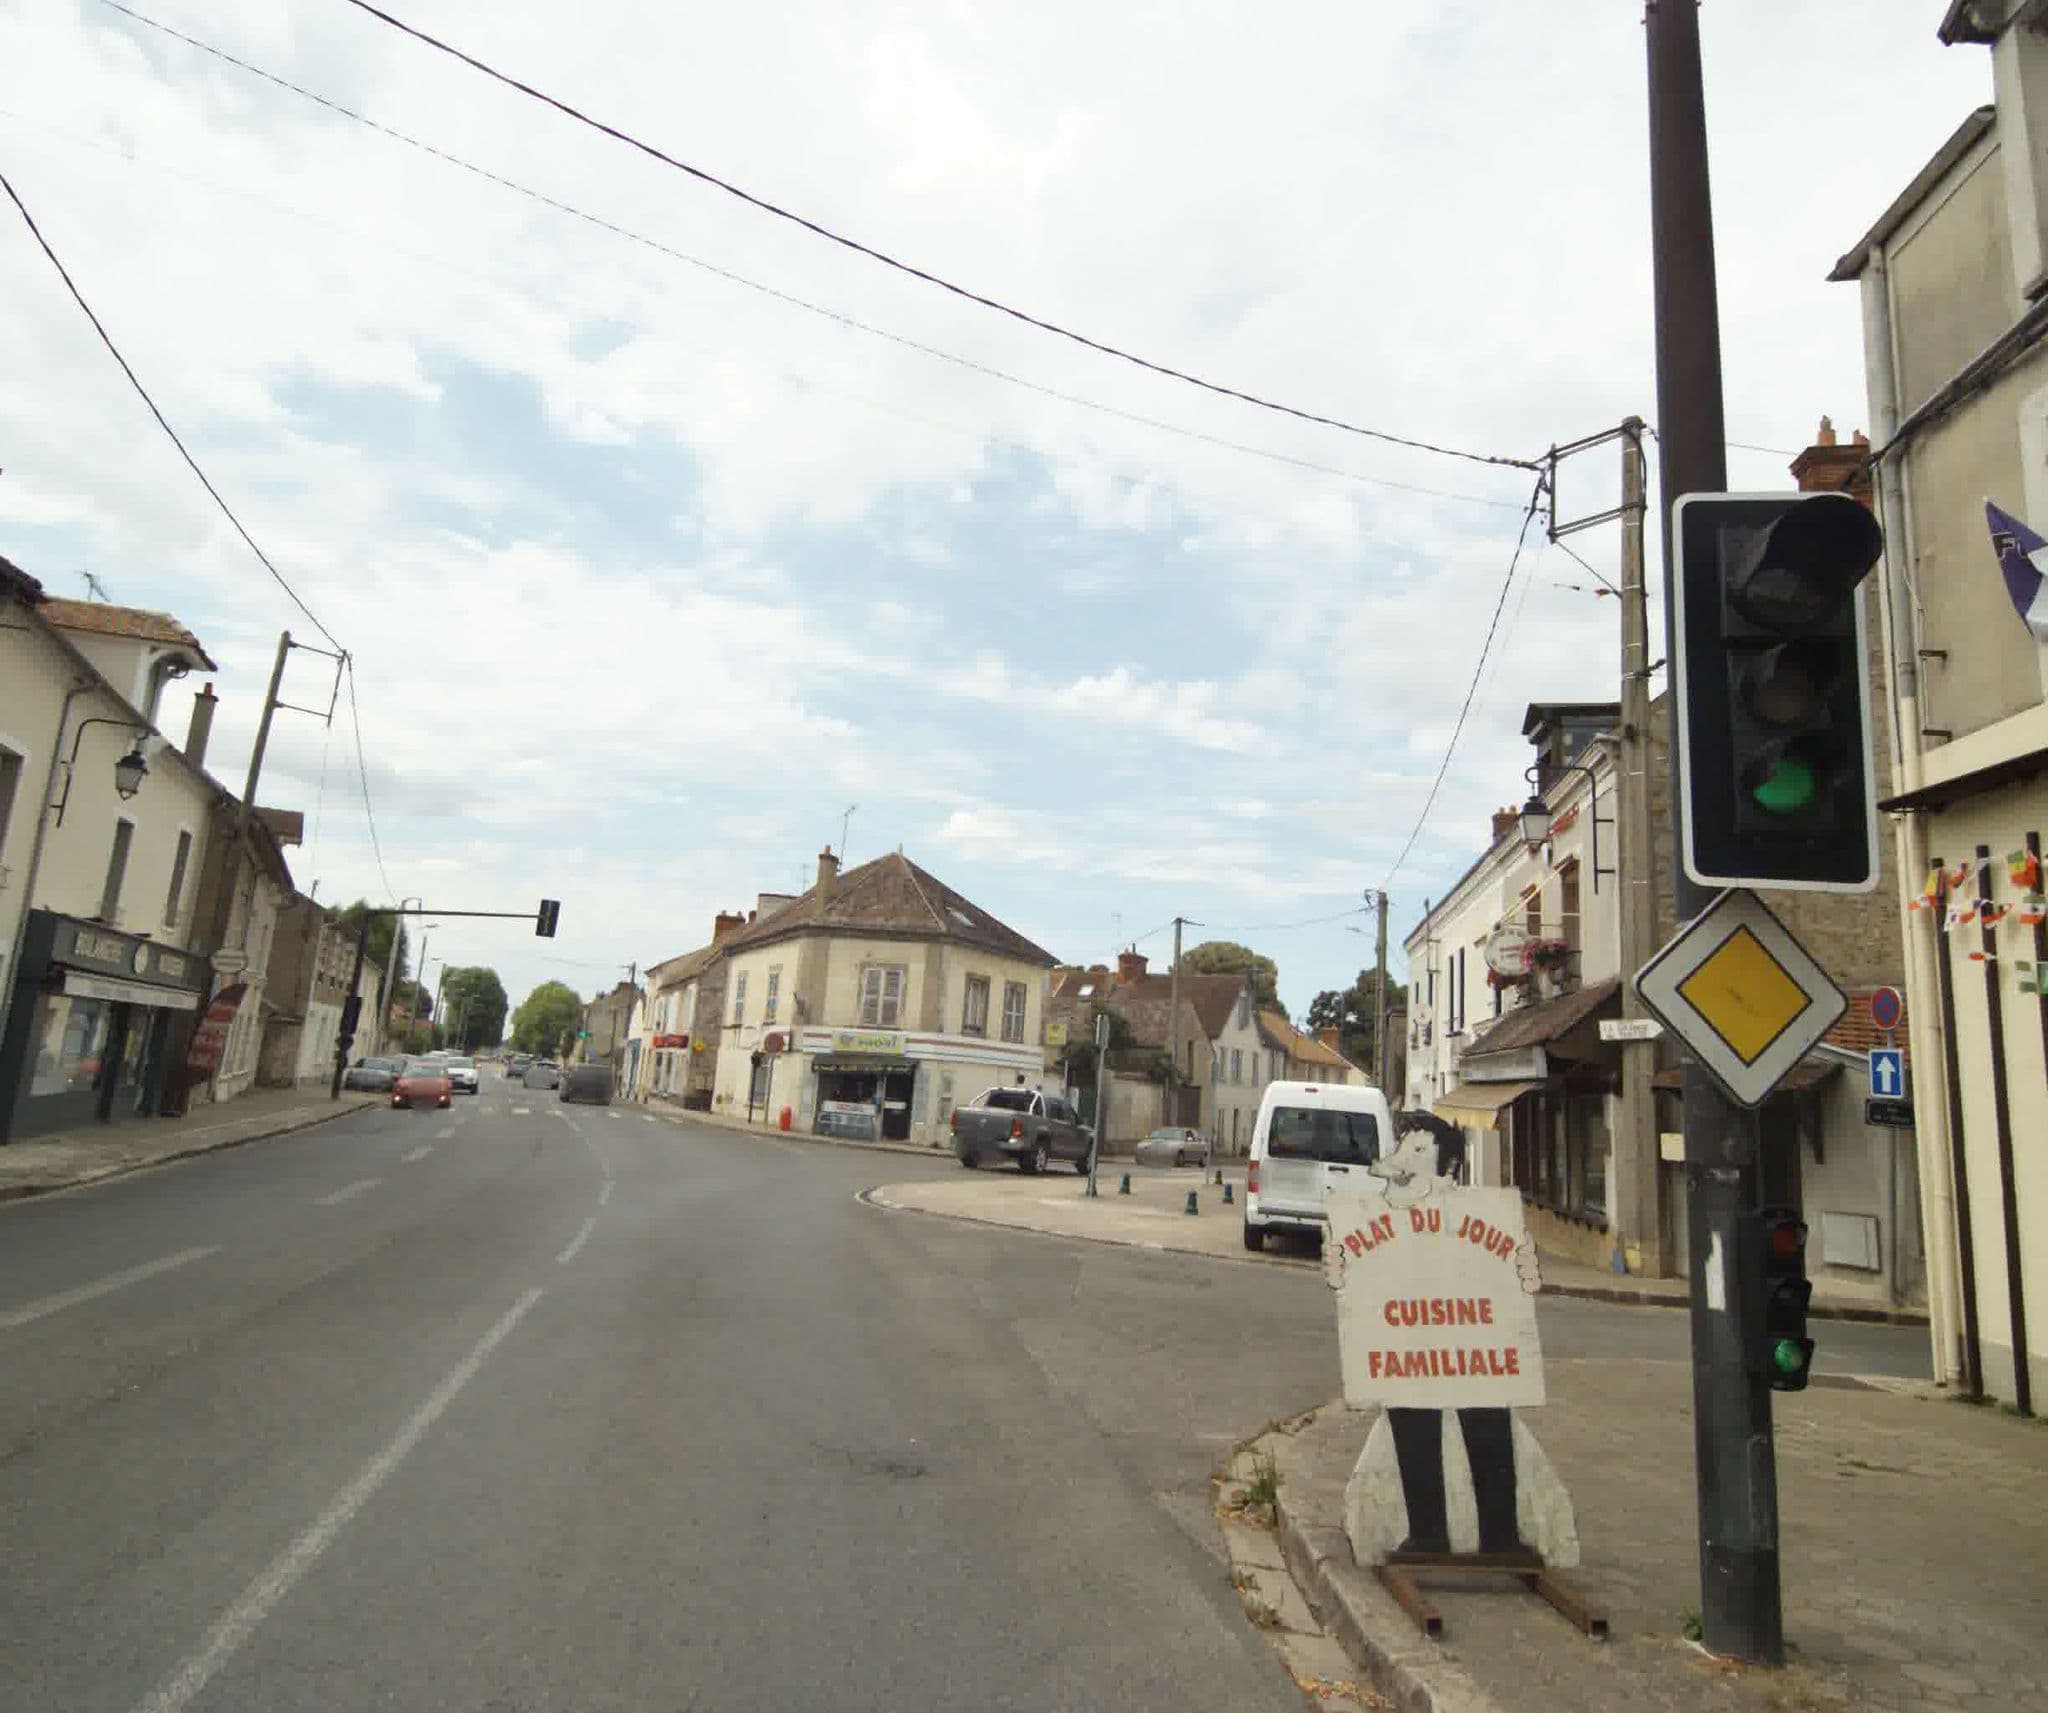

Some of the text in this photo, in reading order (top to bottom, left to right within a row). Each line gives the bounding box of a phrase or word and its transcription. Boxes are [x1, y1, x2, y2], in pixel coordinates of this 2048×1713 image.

[1344, 1207, 1515, 1261] PLAT DU JOUR
[1384, 1298, 1493, 1326] CUISINE
[1368, 1348, 1520, 1379] FAMILIALE
